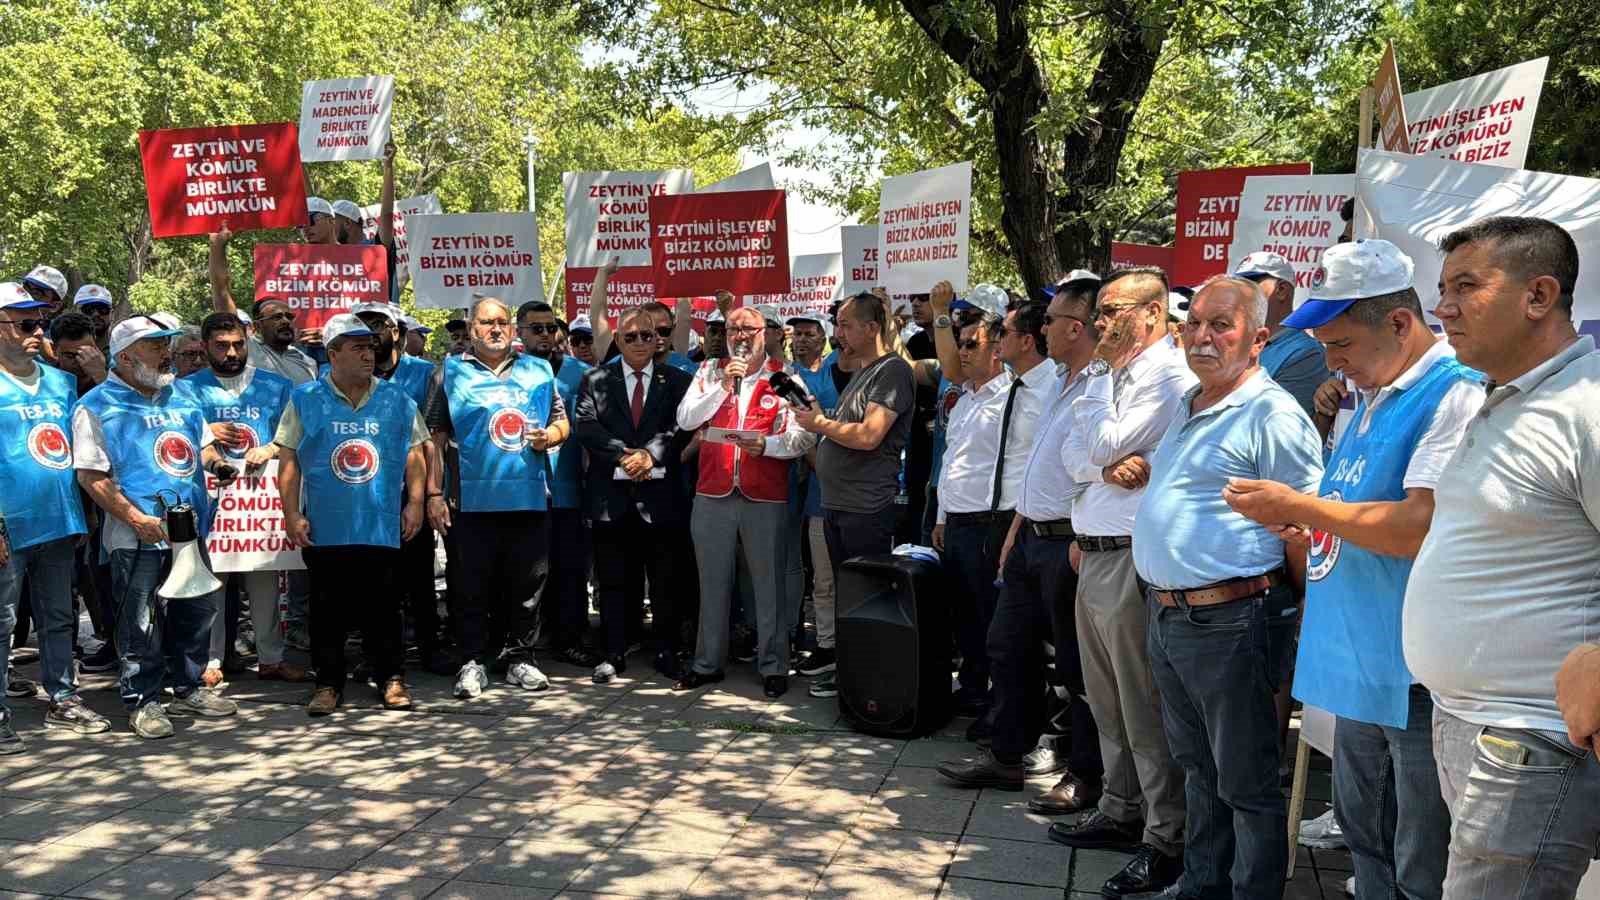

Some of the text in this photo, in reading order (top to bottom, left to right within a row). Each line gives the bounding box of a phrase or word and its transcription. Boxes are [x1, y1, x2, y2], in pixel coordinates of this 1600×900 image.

[320, 88, 374, 103] ZEYTİN VE
[312, 101, 380, 118] MADENCİLİK
[1452, 96, 1525, 129] İŞLEYEN
[321, 118, 368, 132] BİRLİKTE
[1430, 116, 1512, 151] KÖMÜRÜ
[172, 138, 266, 158] ZEYTİN VE
[317, 132, 368, 148] MÜMKÜN
[1465, 140, 1512, 162] BİZİZ
[186, 156, 258, 176] KÖMÜR
[186, 176, 267, 196] BİRLİKTE
[589, 181, 666, 198] ZEYTİN VE
[186, 194, 276, 216] MÜMKÜN
[1264, 190, 1320, 212] ZEYTİN
[884, 200, 962, 224] ZEYTİNİ İŞLEYEN
[658, 219, 776, 238] ZEYTİNİ İŞLEYEN
[886, 218, 956, 244] BİZİZ KÖMÜRÜ
[1185, 217, 1230, 238] BİZİM
[1268, 216, 1332, 238] KÖMÜR
[432, 232, 514, 250] ZEYTİN DE
[664, 234, 771, 254] BİZİZ KÖMÜRÜ
[420, 250, 533, 269] BİZİM KÖMÜR
[886, 240, 958, 269] ÇIKARAN BİZİZ
[1204, 244, 1224, 260] DE
[280, 260, 364, 276] ZEYTİN DE
[666, 253, 775, 276] ÇIKARAN BİZİZ
[266, 277, 380, 292] BİZİM KÖMÜR
[444, 270, 514, 287] DE BİZİM
[792, 275, 836, 291] İŞLEYEN
[288, 294, 360, 309] DE BİZİM
[782, 288, 832, 302] KÖMÜRÜ
[332, 420, 380, 436] TES-İŞ
